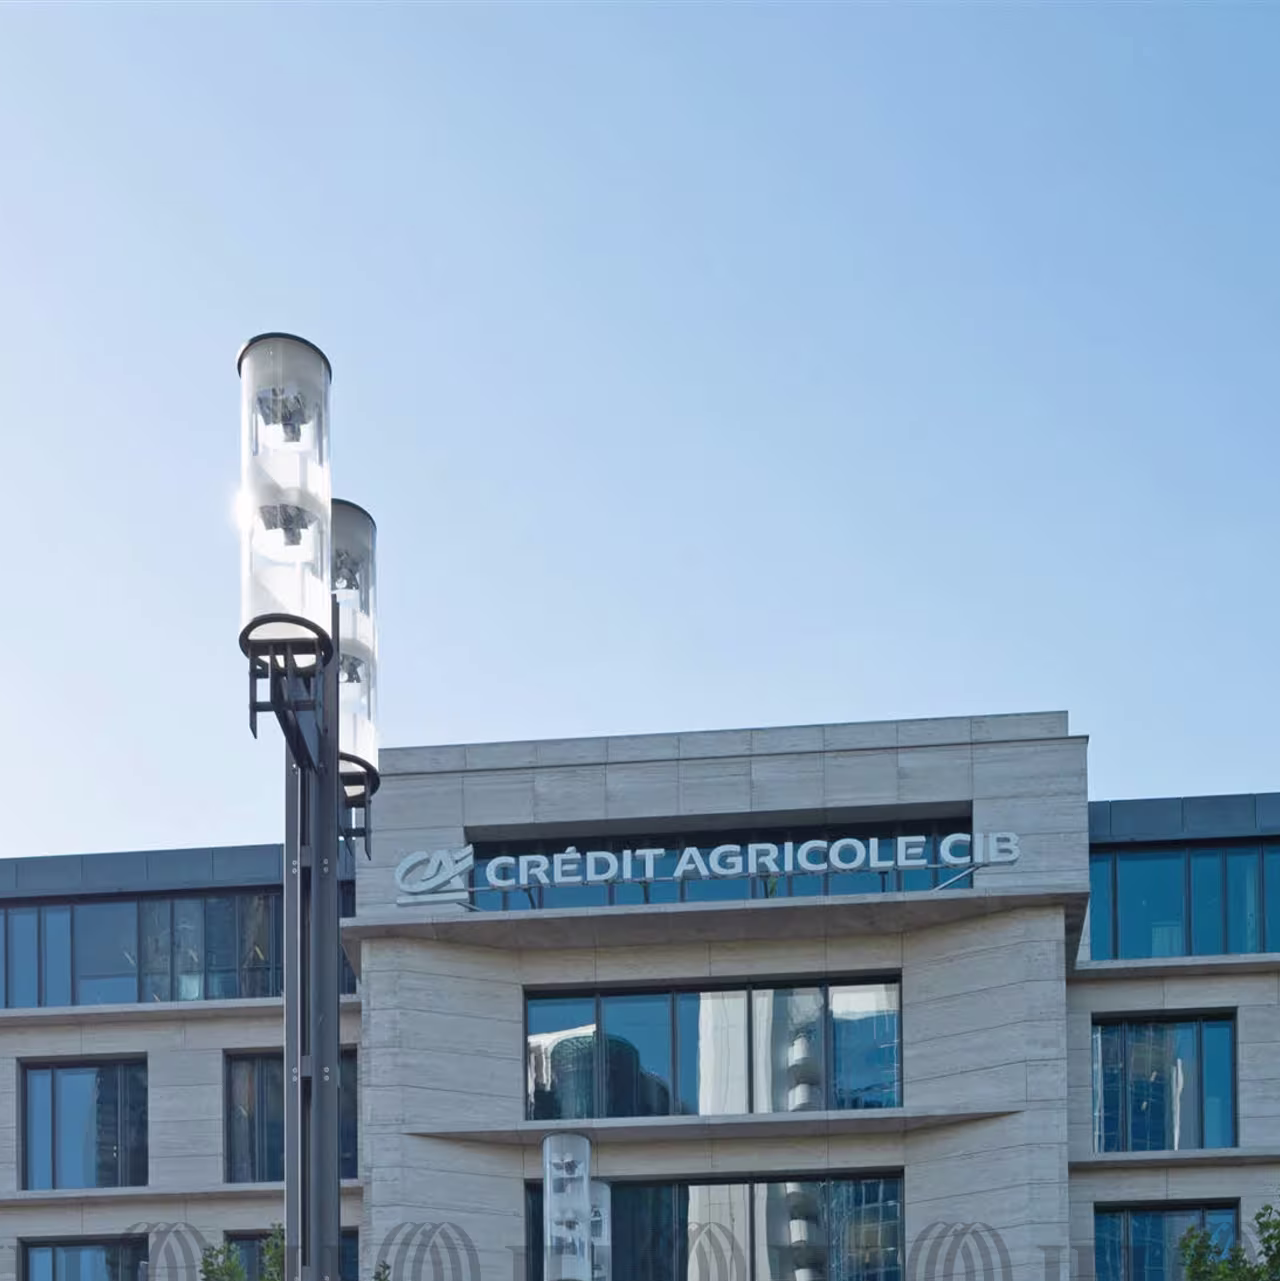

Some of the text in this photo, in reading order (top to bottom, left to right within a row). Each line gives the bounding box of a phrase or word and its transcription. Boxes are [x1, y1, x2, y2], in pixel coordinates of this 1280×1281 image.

[485, 845, 665, 888] CRÉDIT
[673, 835, 927, 879] AGRICOLE
[939, 832, 1021, 866] CIB
